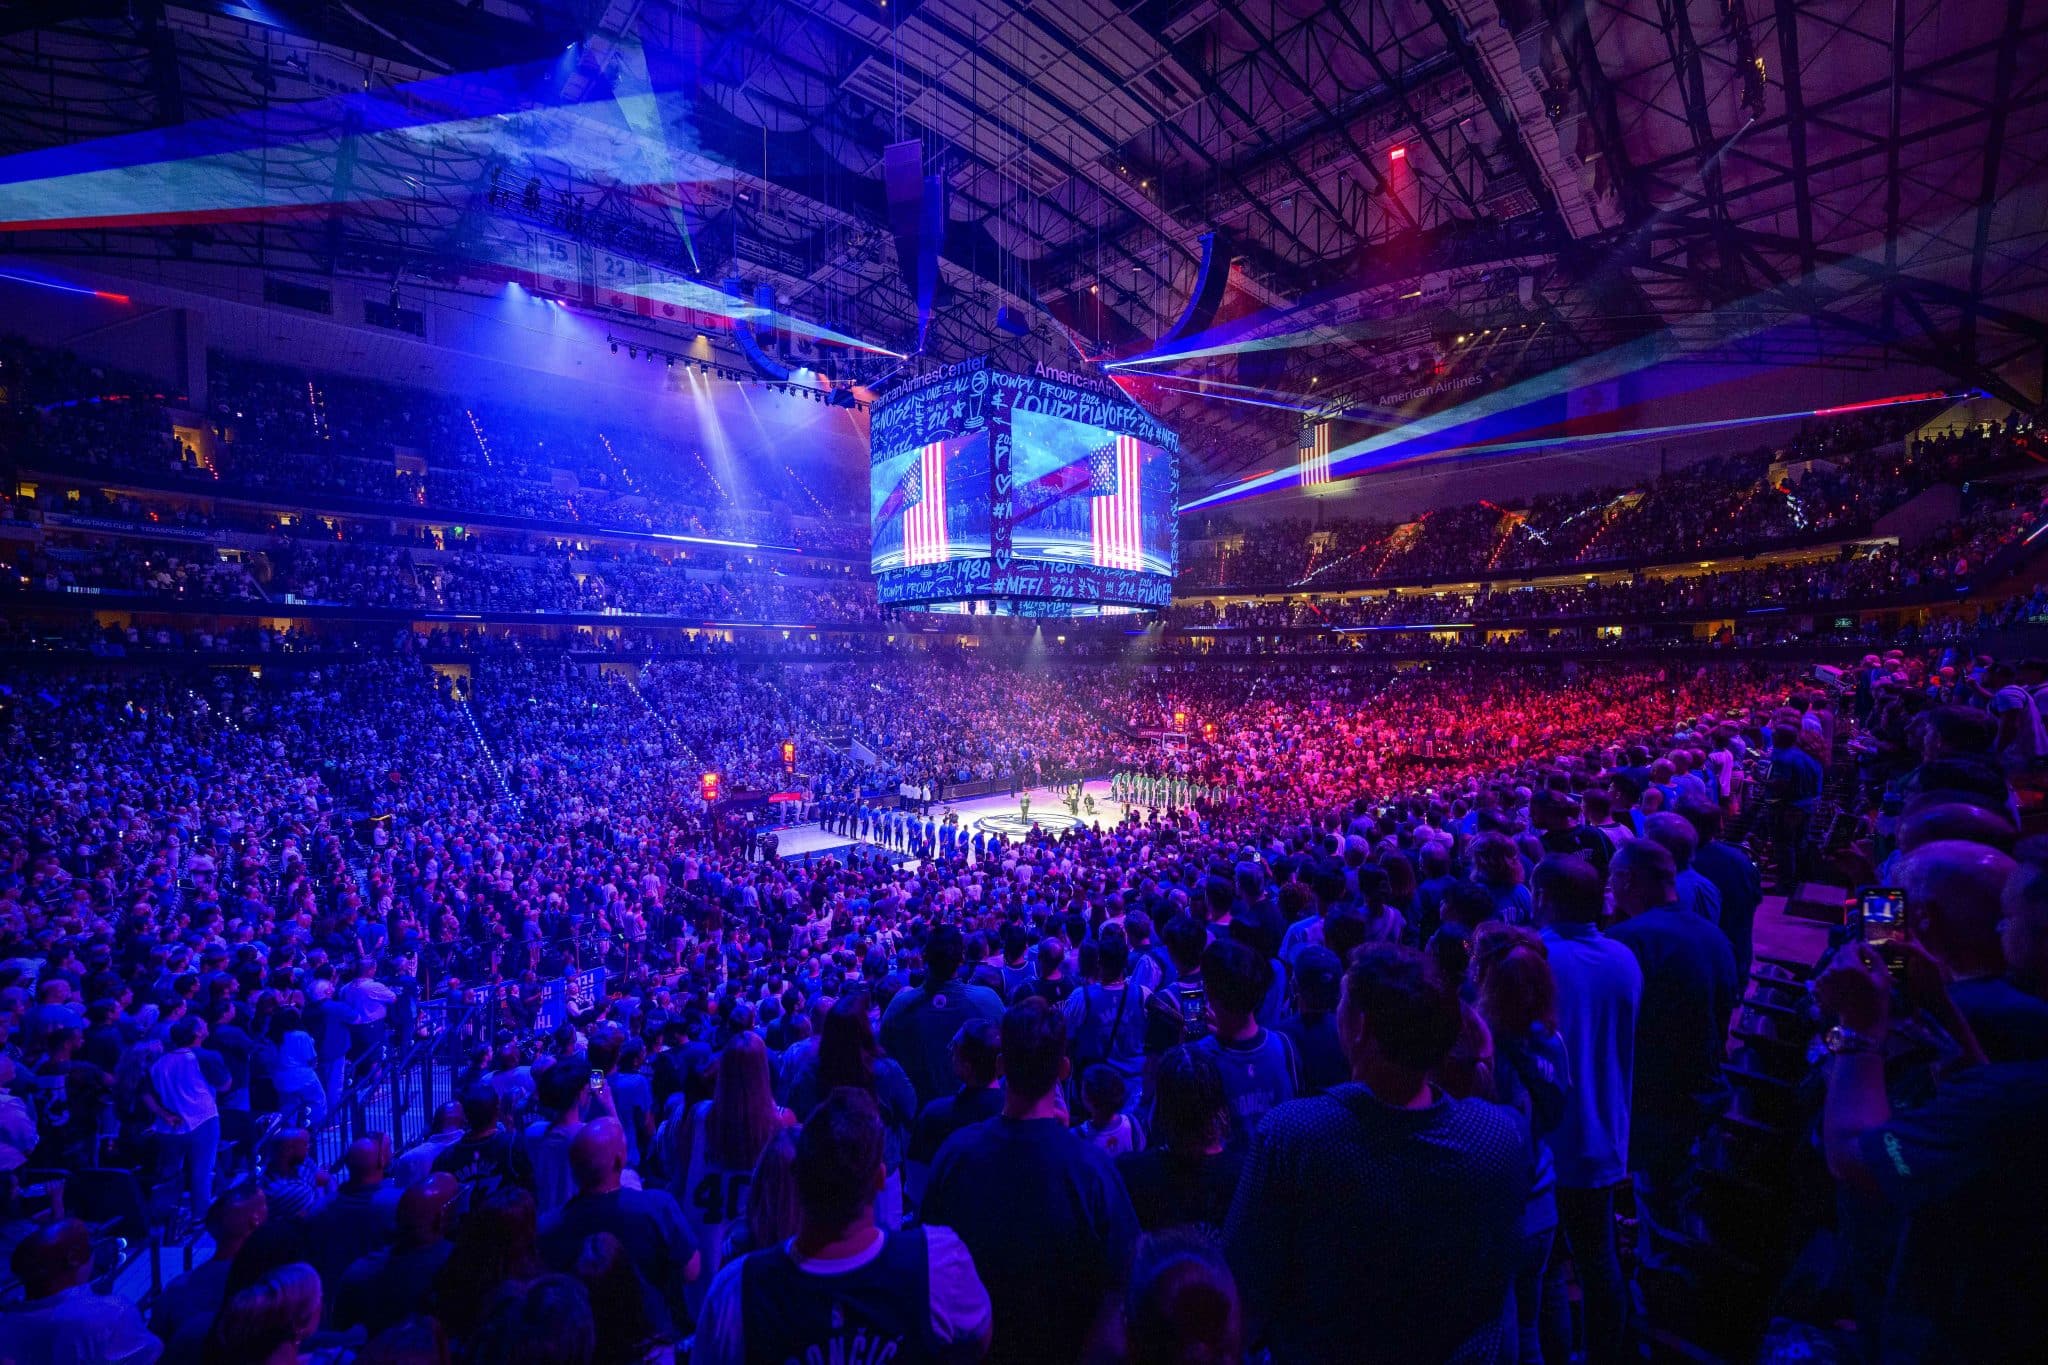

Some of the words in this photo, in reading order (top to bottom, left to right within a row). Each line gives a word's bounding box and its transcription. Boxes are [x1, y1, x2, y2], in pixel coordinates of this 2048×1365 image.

[604, 256, 625, 278] 22
[1039, 382, 1078, 400] PROUD
[1379, 386, 1434, 406] American
[1434, 374, 1483, 393] Airlines
[927, 409, 951, 431] 214
[957, 560, 990, 581] 1980
[1117, 581, 1137, 598] 214
